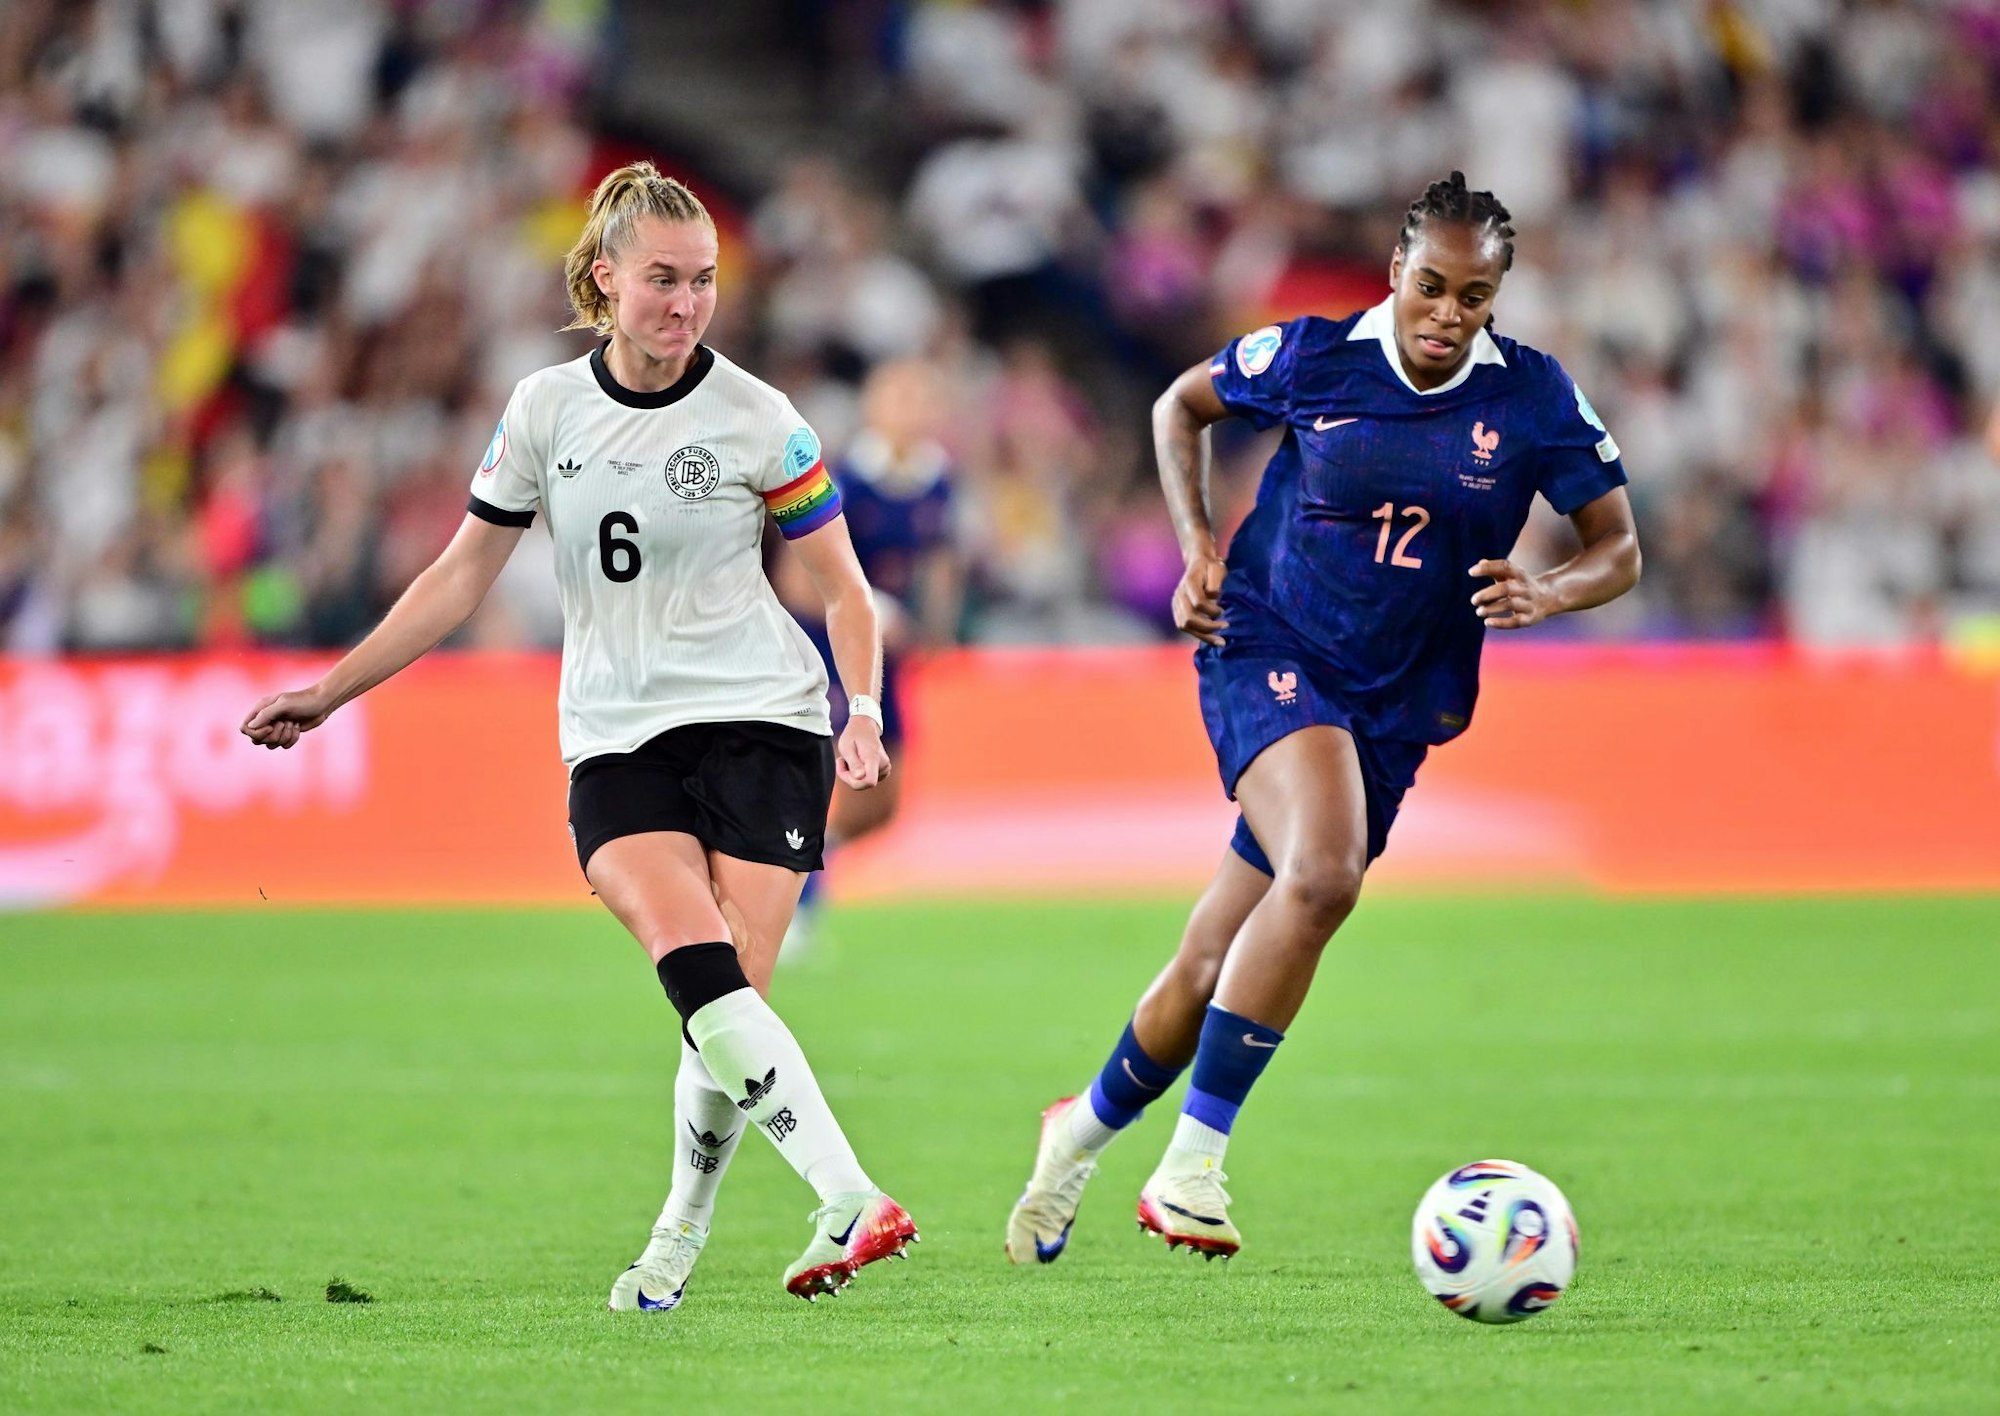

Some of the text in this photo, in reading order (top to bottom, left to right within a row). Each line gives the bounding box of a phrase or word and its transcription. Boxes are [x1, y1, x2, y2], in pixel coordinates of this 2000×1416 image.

[668, 451, 685, 490] DEUTSCHER
[599, 511, 641, 583] 6
[1372, 502, 1430, 569] 12
